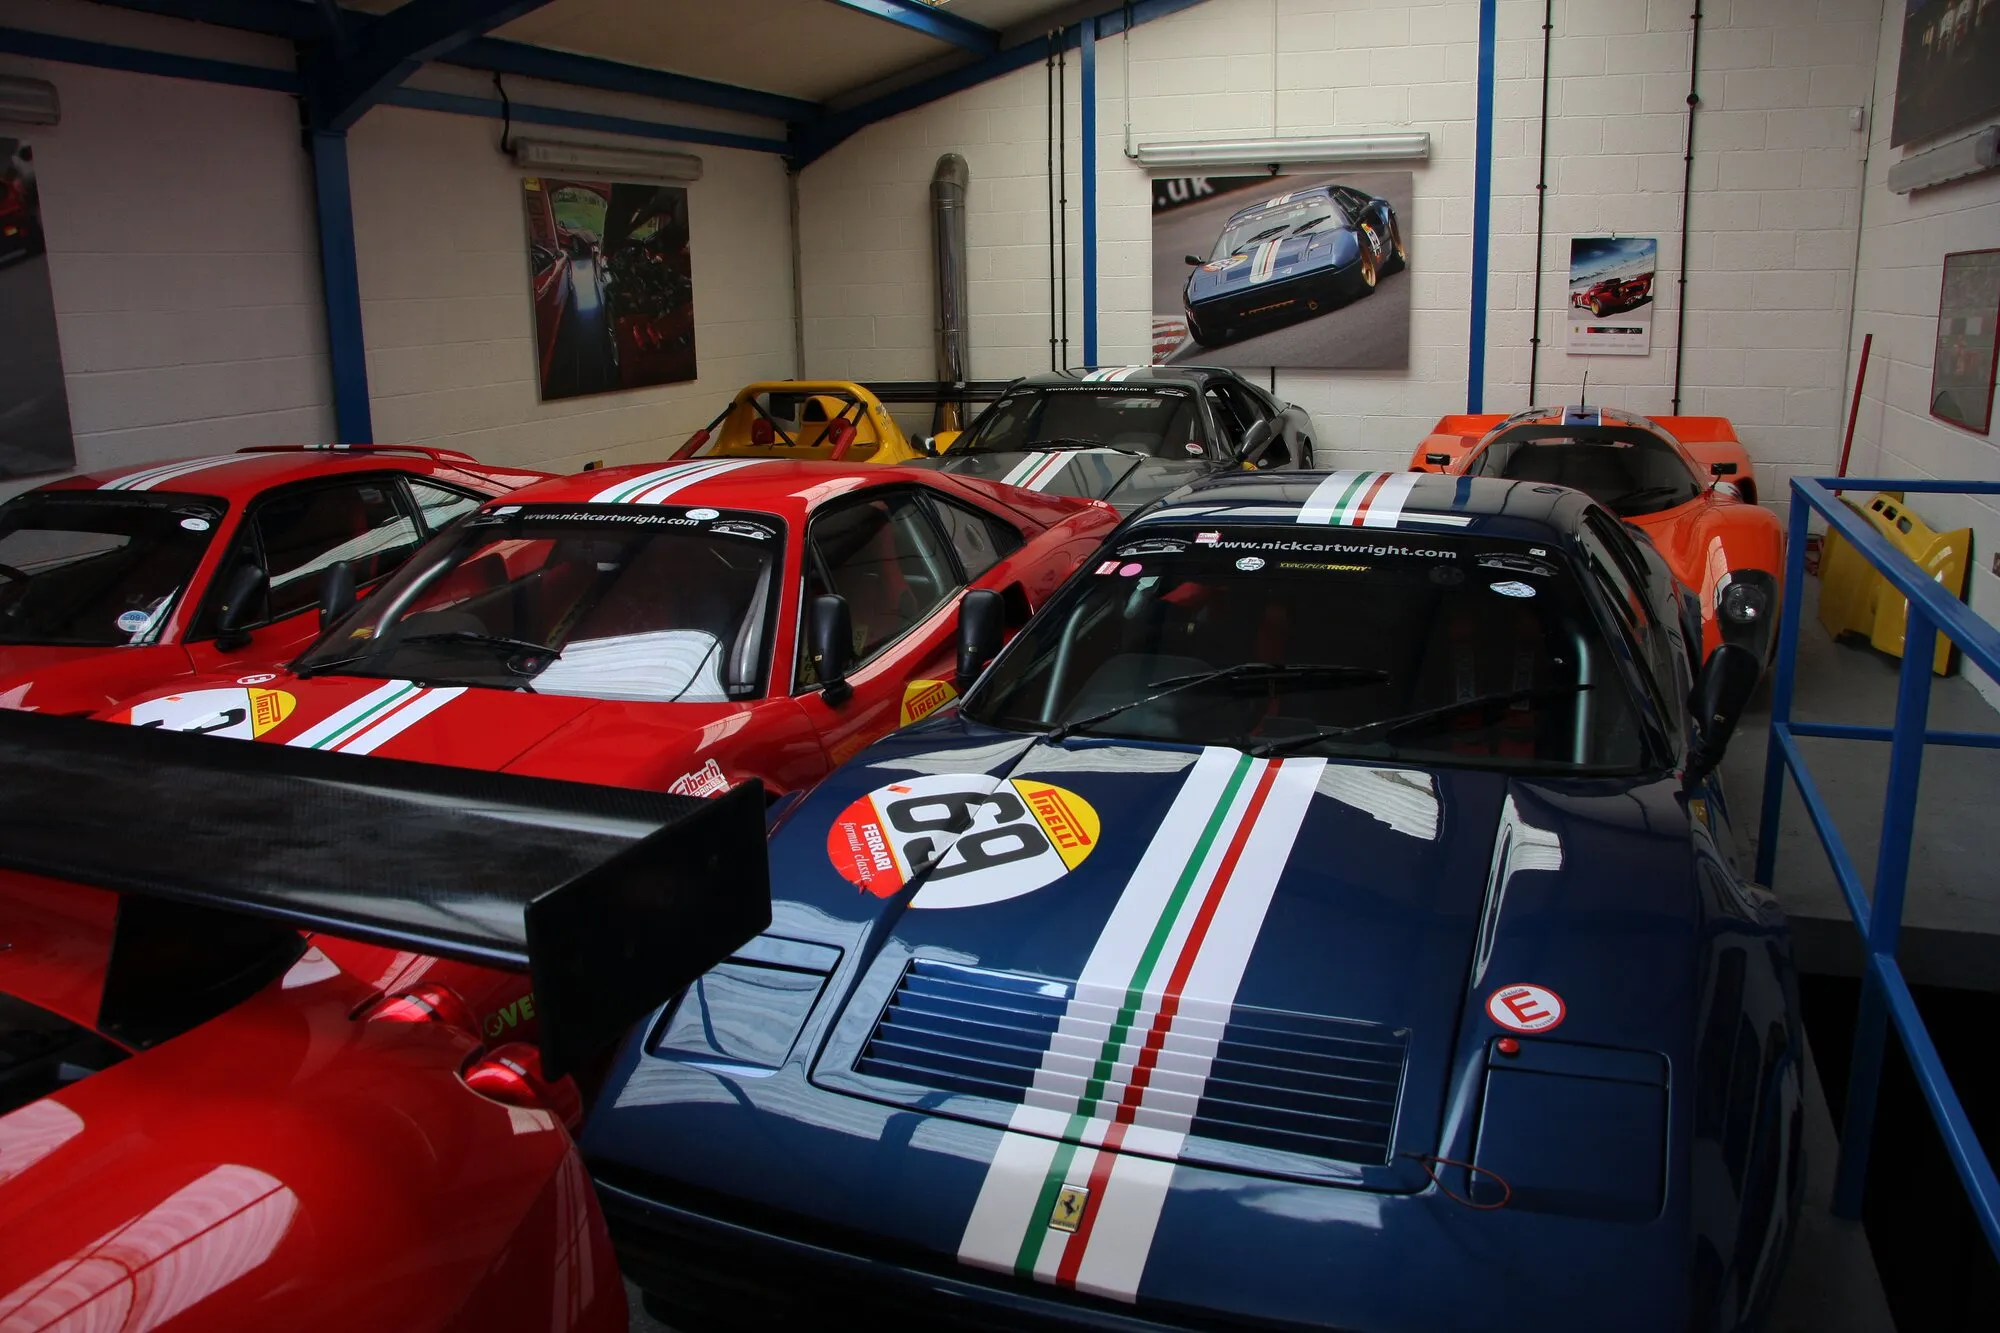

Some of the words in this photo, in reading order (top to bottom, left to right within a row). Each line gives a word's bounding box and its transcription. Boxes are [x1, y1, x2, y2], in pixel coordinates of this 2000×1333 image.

[523, 512, 700, 527] www.nickcartwright.com
[1207, 540, 1457, 560] www.nickcartwright.com
[256, 692, 282, 726] PIRELLI
[905, 681, 948, 721] PIRELLI
[885, 791, 1050, 882] 69
[1027, 788, 1092, 849] PIRELLI
[838, 821, 862, 853] formula
[854, 850, 875, 883] classic
[860, 822, 893, 872] FERRARI
[1500, 990, 1552, 1024] E
